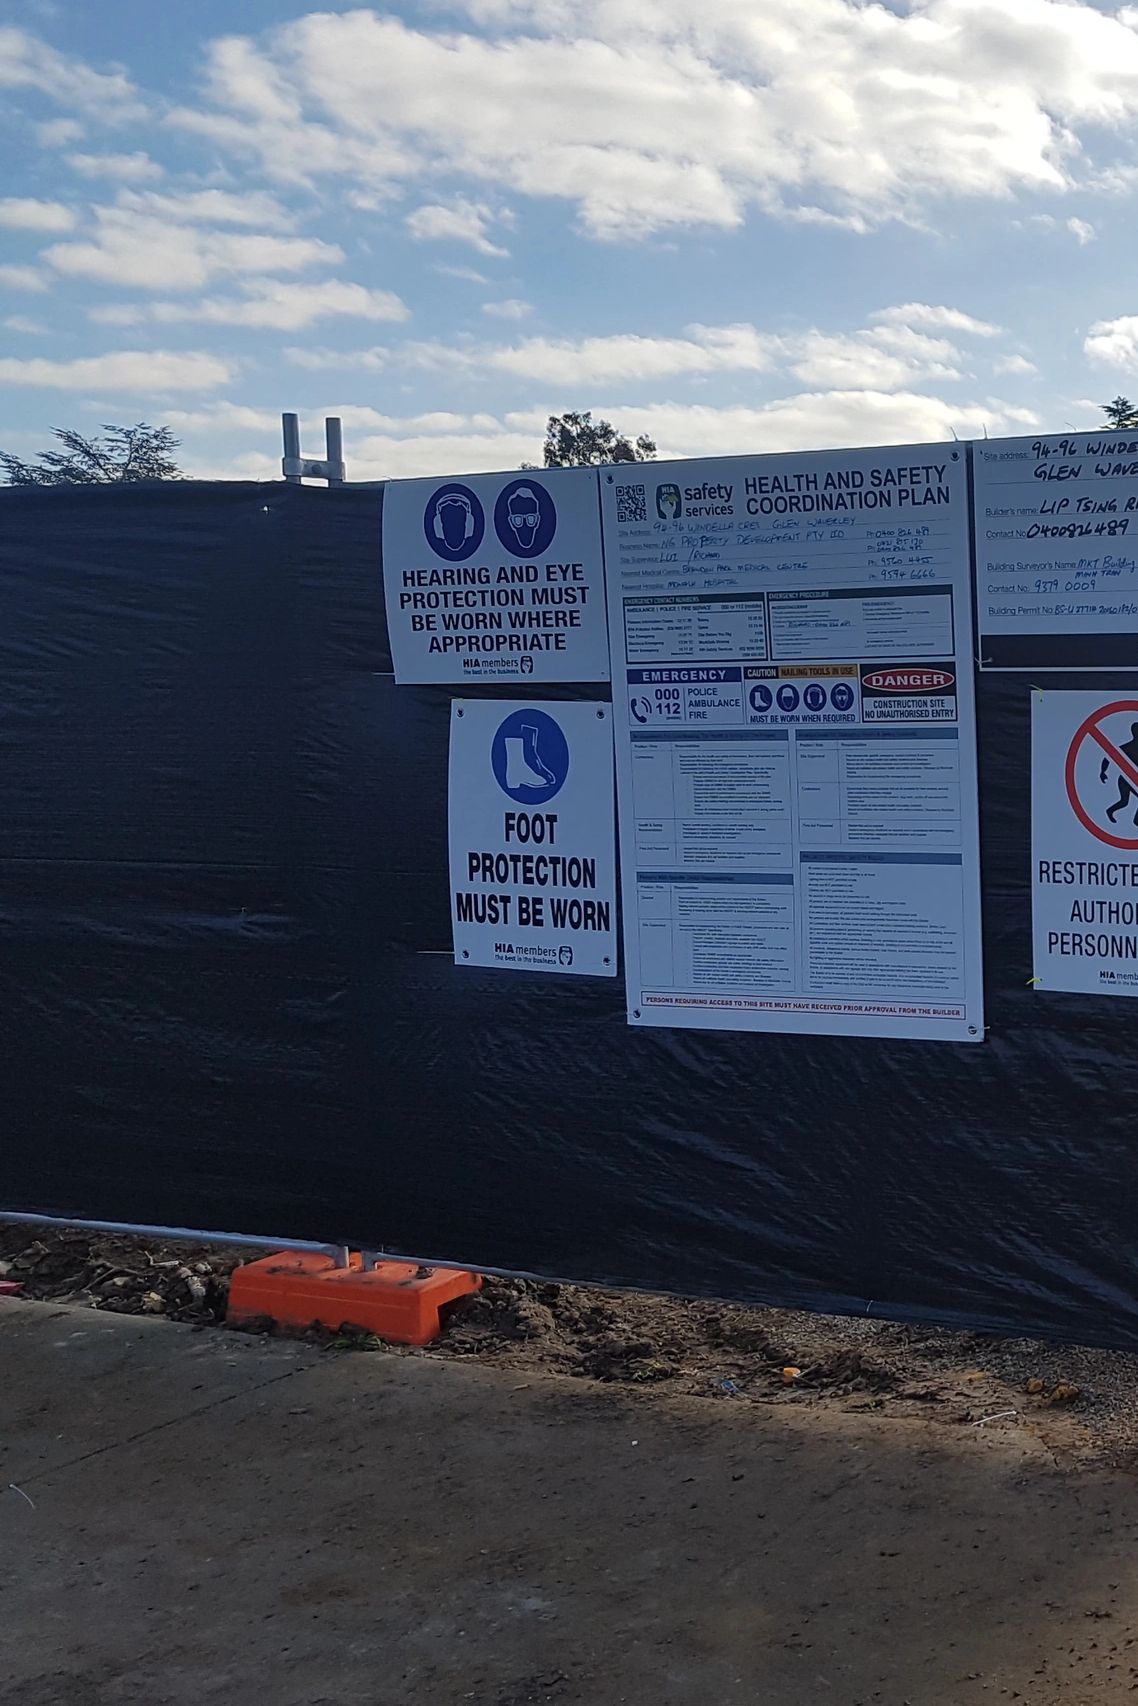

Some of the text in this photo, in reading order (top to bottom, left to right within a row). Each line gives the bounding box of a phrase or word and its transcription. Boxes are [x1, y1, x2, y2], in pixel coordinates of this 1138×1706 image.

[1031, 439, 1077, 460] 94-96
[984, 452, 997, 460] Site
[1033, 462, 1083, 481] GLEN
[744, 465, 947, 495] HEALTH AND SAFETY
[660, 486, 675, 494] HIA
[684, 482, 733, 503] safety
[746, 486, 950, 515] COORDINATION PLAN
[1039, 498, 1070, 515] LIP
[1076, 497, 1117, 514] TSING
[685, 504, 734, 517] services
[985, 507, 1016, 517] Builder's
[772, 519, 800, 529] GLEN
[806, 530, 824, 540] PTY
[985, 530, 1014, 539] Contact
[986, 561, 1015, 571] Building
[1102, 555, 1135, 573] Building
[402, 563, 585, 587] HEARING AND EYE
[987, 584, 1015, 593] Contact
[1034, 579, 1096, 593] 9379 0009
[400, 586, 590, 609] PROTECTION MUST
[988, 606, 1041, 616] Building Permit
[411, 610, 582, 632] BE WORN WHERE
[428, 633, 567, 653] APPROPRIATE
[463, 658, 480, 668] HIA
[481, 657, 519, 668] members
[642, 670, 727, 682] EMERGENCY
[747, 666, 854, 678] CAUTION NAILING TOOLS IN USE
[871, 674, 945, 686] DANGER
[654, 688, 680, 700] 000
[687, 687, 718, 696] POLICE
[655, 702, 681, 715] 112
[687, 699, 740, 708] AMBULANCE
[873, 699, 945, 709] CONSTRUCTION SITE
[689, 711, 708, 719] FIRE
[750, 713, 856, 723] MUST BE WORN WHEN REQUIRED
[865, 708, 954, 719] NO UNAUTHORISED ENTRY
[504, 812, 558, 844] FOOT
[468, 852, 596, 889] PROTECTION
[456, 892, 511, 925] MUST
[518, 896, 544, 927] BE
[550, 898, 610, 932] WORN
[494, 942, 514, 954] HIA
[515, 945, 557, 957] members
[504, 954, 516, 962] best
[1099, 970, 1116, 979] HIA
[646, 996, 673, 1004] PERSONS
[674, 997, 707, 1005] REQUIRING
[811, 1003, 842, 1011] RECEIVED
